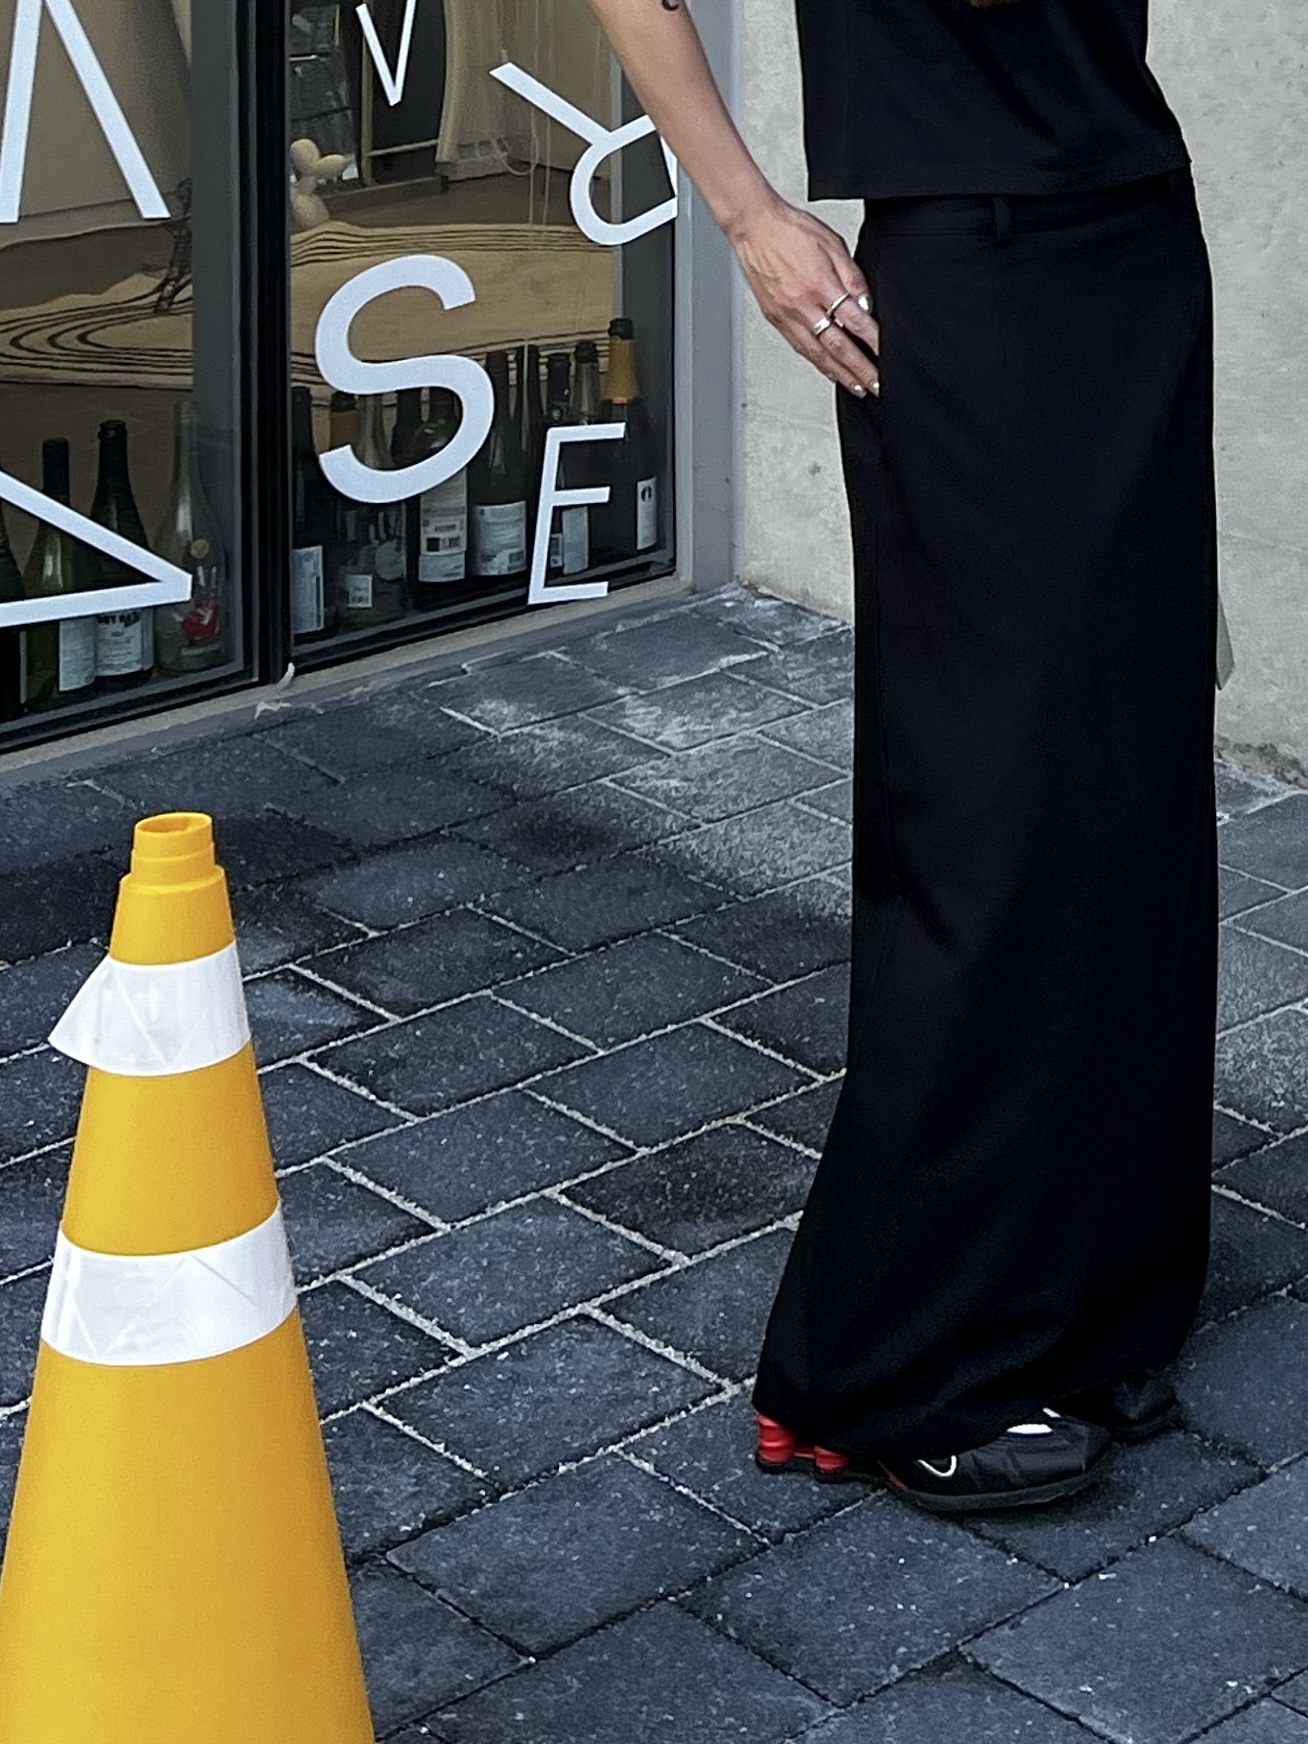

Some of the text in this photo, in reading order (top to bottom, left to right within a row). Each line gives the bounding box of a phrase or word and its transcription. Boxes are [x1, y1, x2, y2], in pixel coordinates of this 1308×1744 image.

[489, 62, 678, 246] R
[315, 254, 494, 504] S
[528, 422, 626, 605] E
